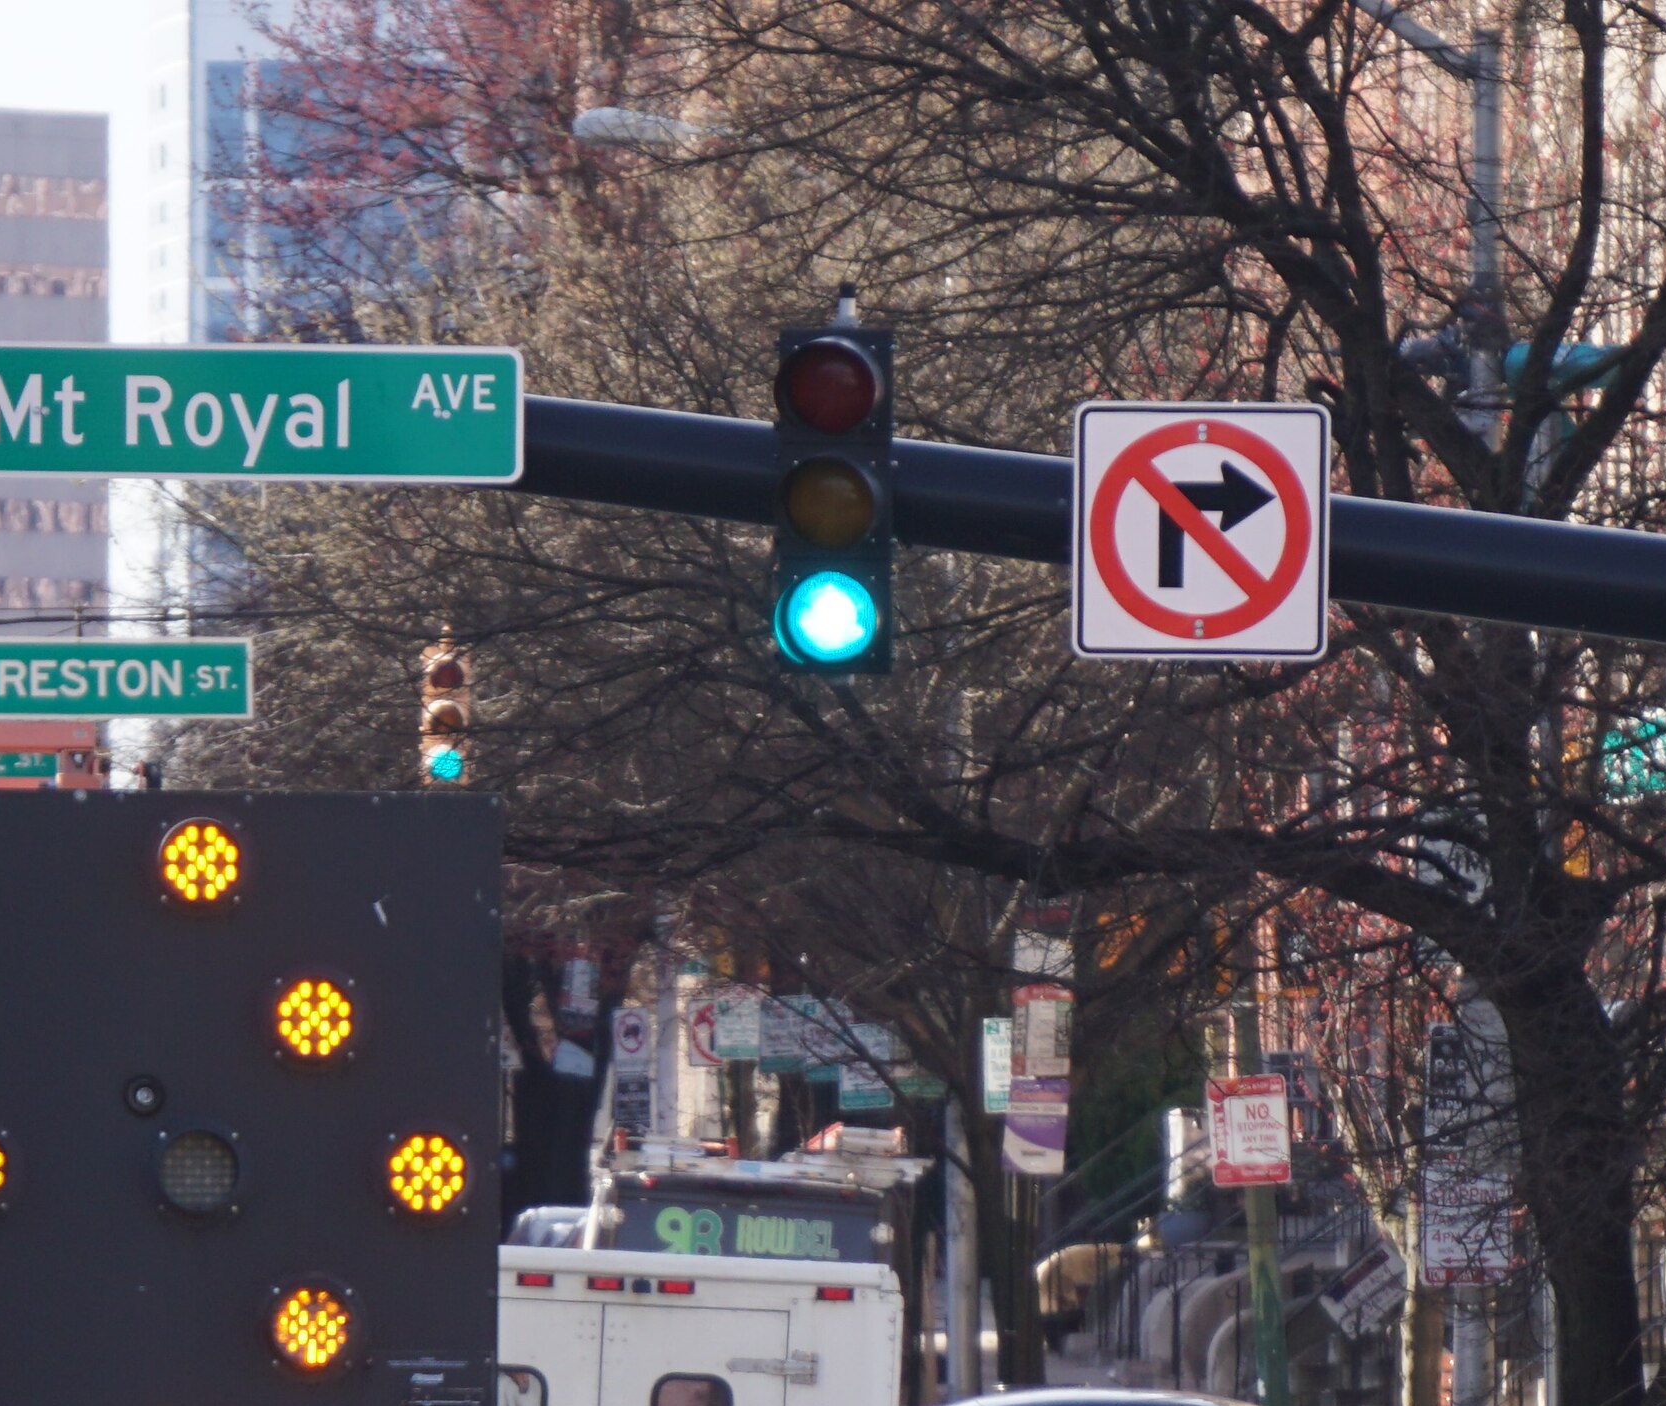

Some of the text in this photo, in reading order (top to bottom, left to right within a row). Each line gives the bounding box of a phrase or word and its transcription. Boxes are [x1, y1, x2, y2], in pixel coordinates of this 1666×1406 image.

[125, 373, 351, 468] Royal
[411, 373, 496, 412] AVE
[196, 665, 238, 690] ST.
[1245, 1103, 1269, 1120] NO
